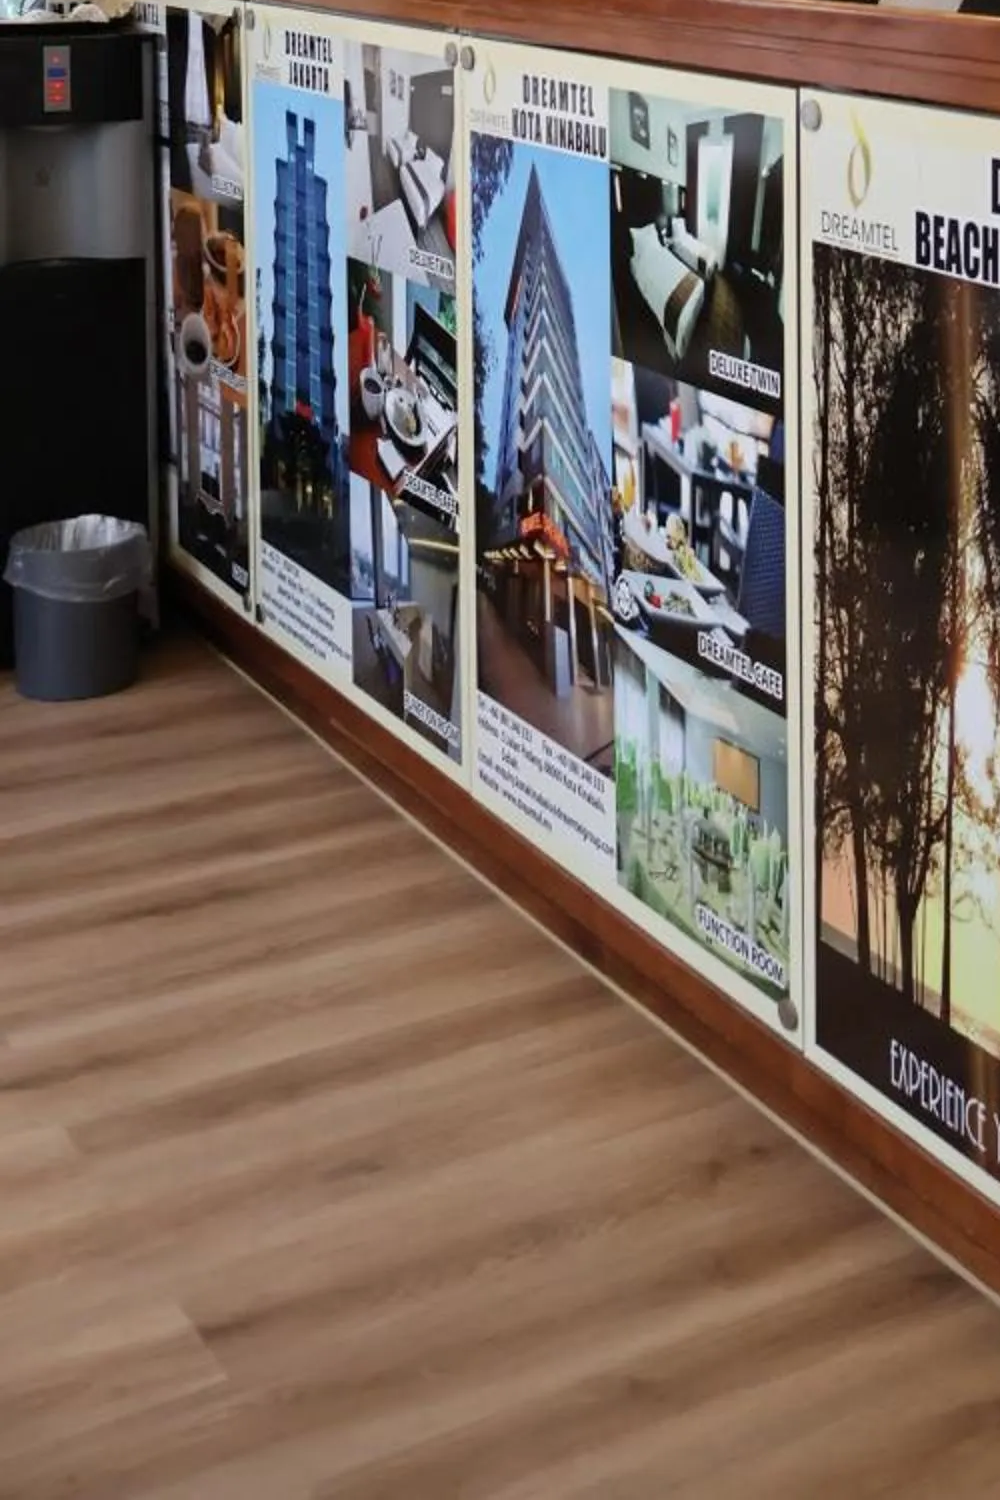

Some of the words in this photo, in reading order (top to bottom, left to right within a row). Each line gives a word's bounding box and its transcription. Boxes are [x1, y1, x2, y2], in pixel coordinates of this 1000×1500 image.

[285, 30, 333, 64] DREAMTEL
[289, 60, 329, 92] JAKARTA
[522, 74, 594, 117] DREAMTEL
[511, 108, 542, 143] KOTA
[545, 115, 606, 158] KINABALU
[821, 210, 899, 251] DREAMTEL
[914, 210, 999, 285] BEACH
[711, 353, 749, 383] DELUXE
[700, 634, 753, 681] DREAMTEL
[699, 907, 749, 960] FUNCTION
[751, 946, 783, 982] ROOM
[889, 1038, 988, 1154] EXPERIENCE
